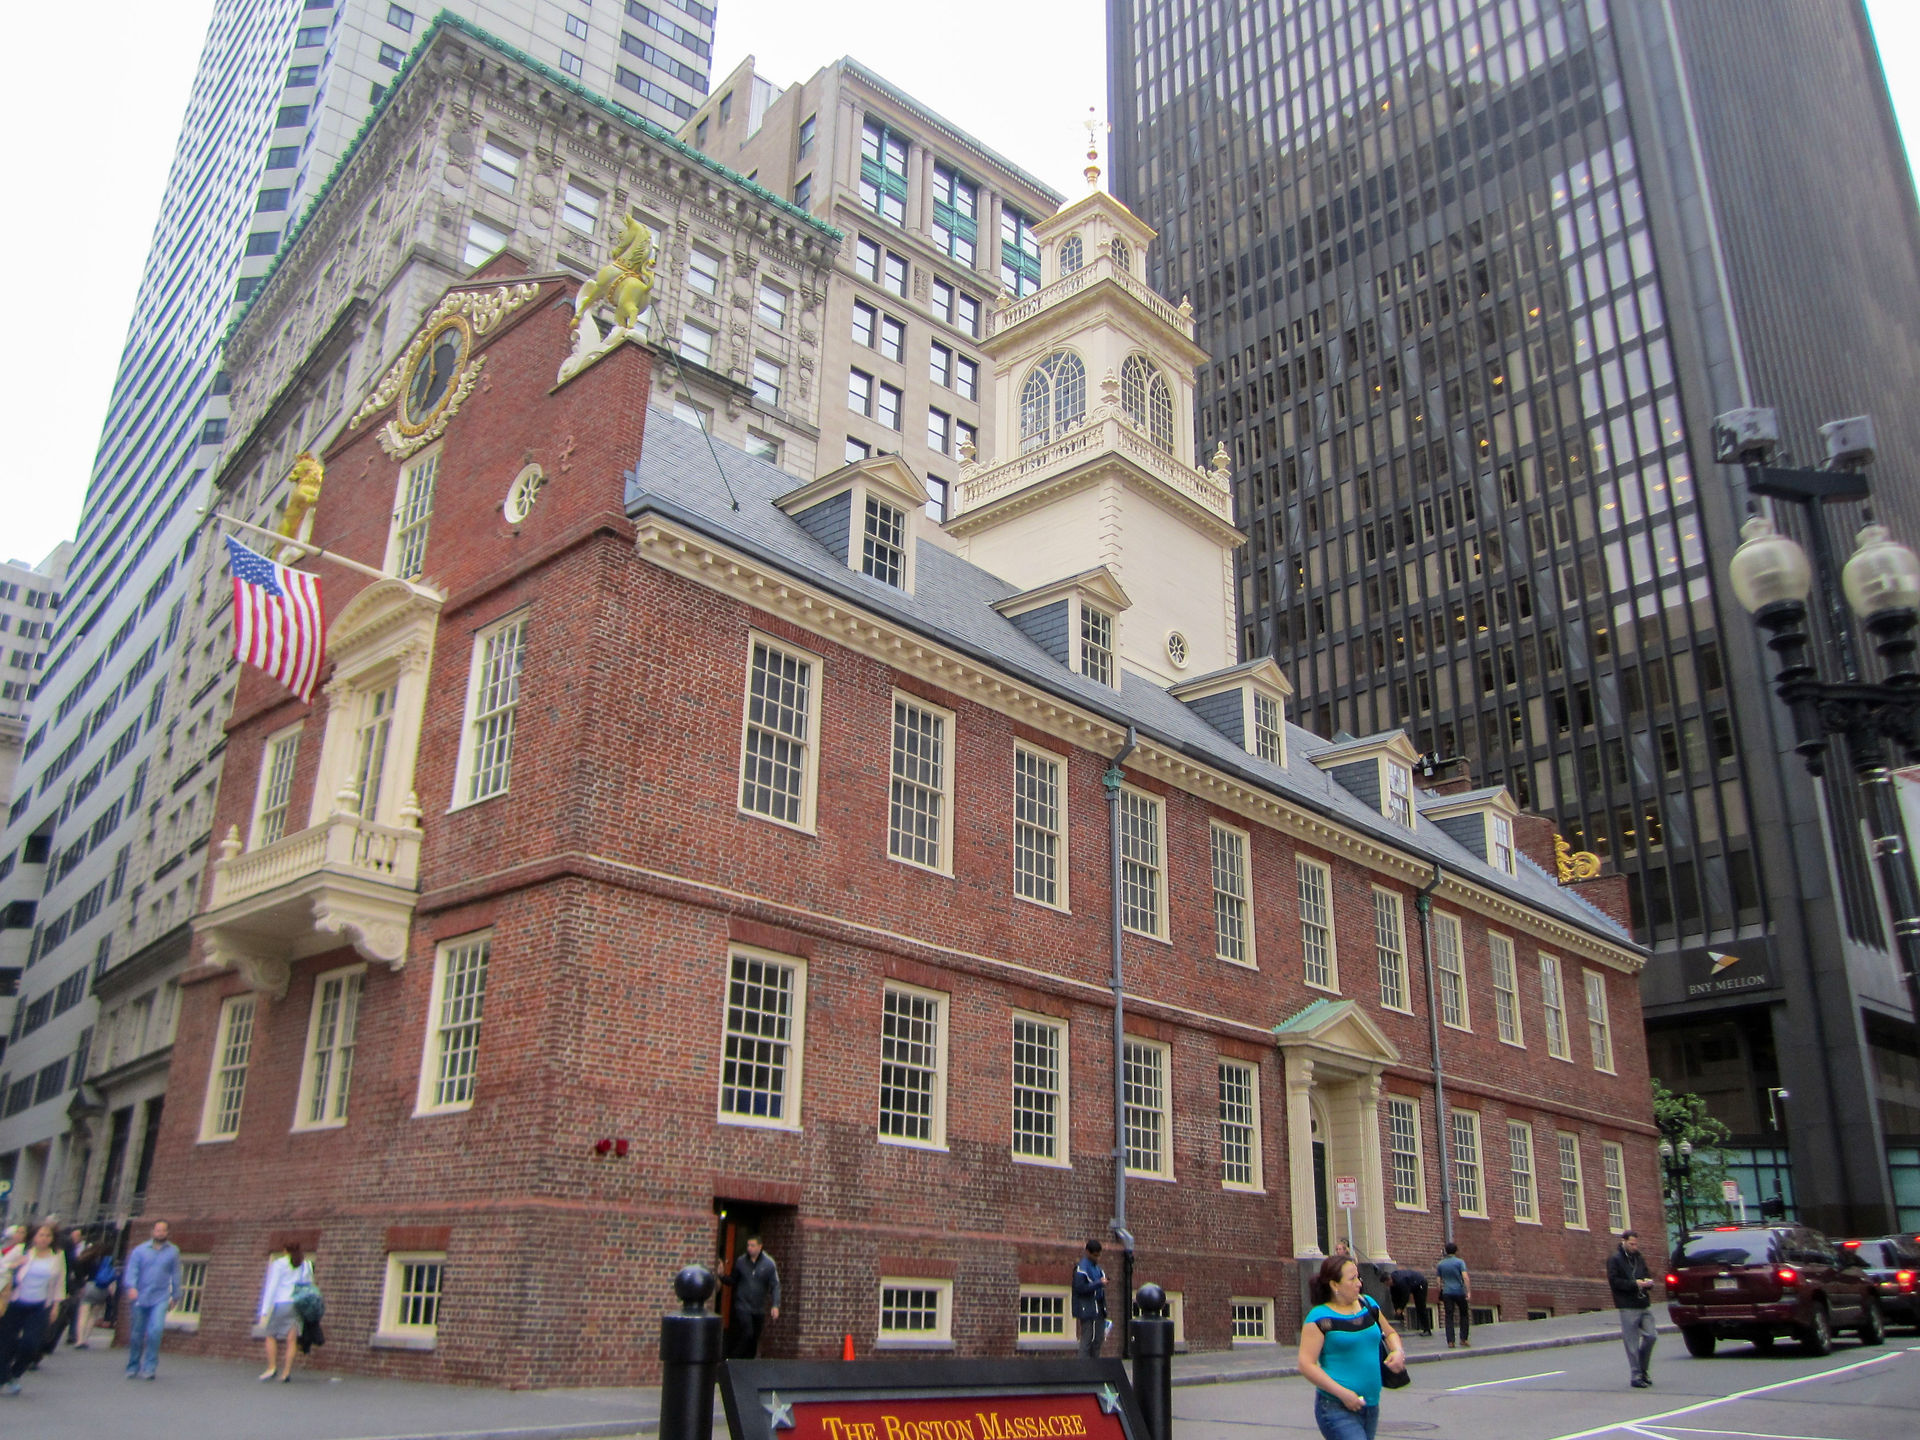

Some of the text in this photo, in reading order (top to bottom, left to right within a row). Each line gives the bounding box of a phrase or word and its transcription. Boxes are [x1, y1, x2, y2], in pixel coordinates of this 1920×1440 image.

[1689, 975, 1765, 994] BNY MELLON
[821, 1412, 1087, 1440] THE BOSTON MASSACRE
